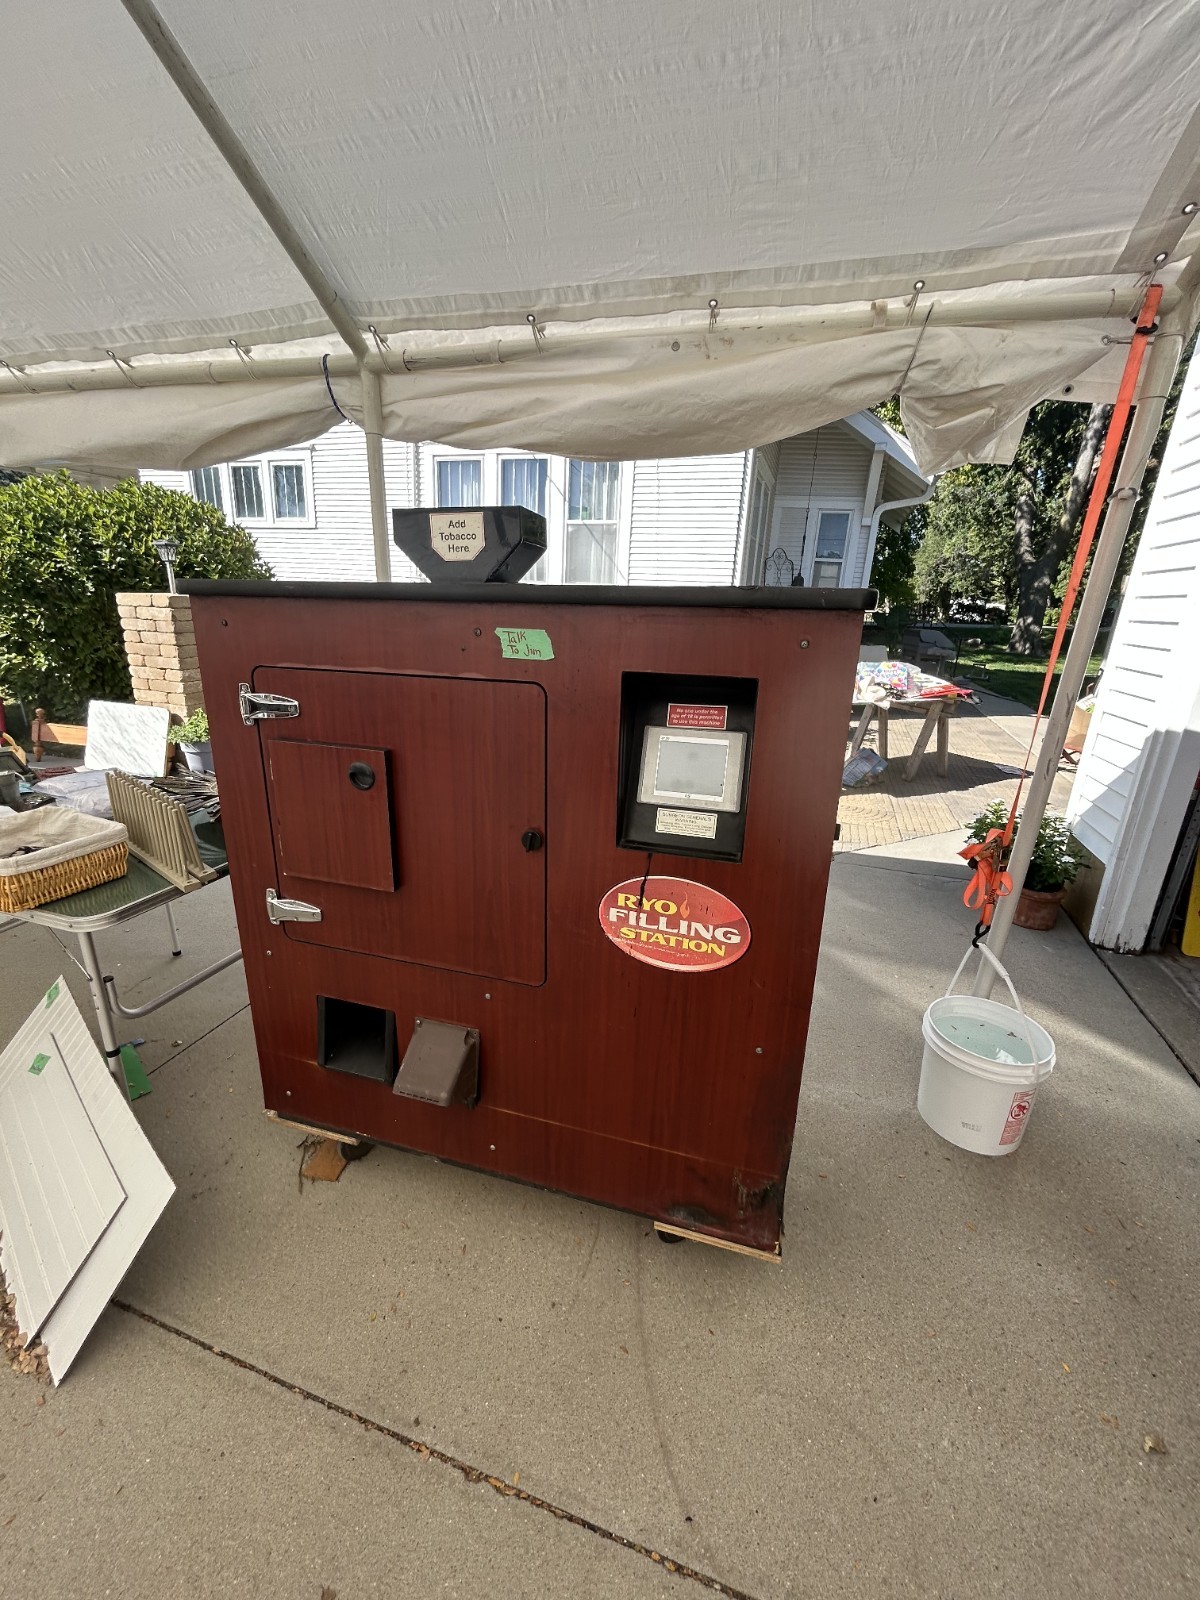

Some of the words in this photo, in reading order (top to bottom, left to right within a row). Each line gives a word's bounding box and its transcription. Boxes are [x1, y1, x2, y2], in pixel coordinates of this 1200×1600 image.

[448, 520, 466, 529] Add
[439, 532, 477, 541] Tobacco
[448, 544, 470, 553] Here
[507, 644, 520, 655] To
[523, 643, 542, 658] Jim
[617, 893, 678, 915] RYO
[608, 907, 742, 944] FILLING
[619, 926, 726, 957] STATION
